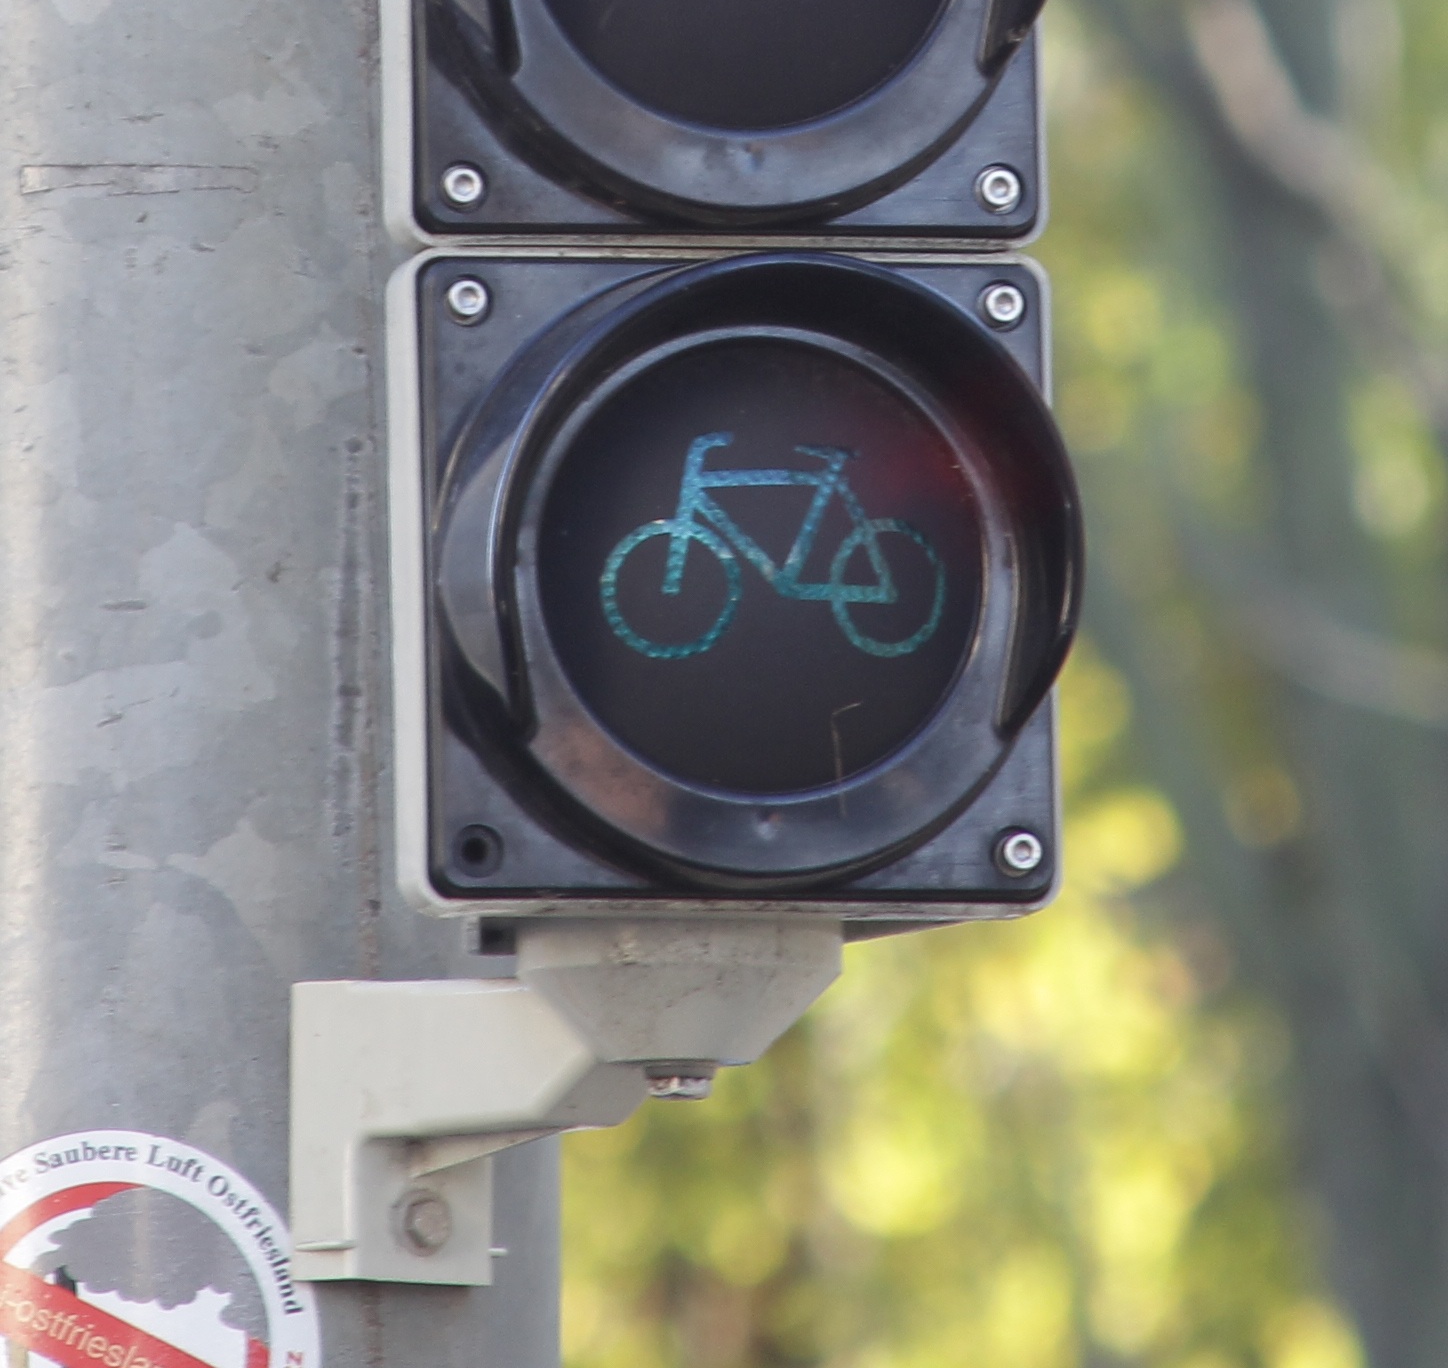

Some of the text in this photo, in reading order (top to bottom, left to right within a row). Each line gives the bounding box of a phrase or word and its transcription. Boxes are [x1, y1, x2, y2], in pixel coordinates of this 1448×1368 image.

[33, 1140, 139, 1175] Saubere
[144, 1143, 206, 1183] Luft
[207, 1174, 304, 1315] Ostfriesland
